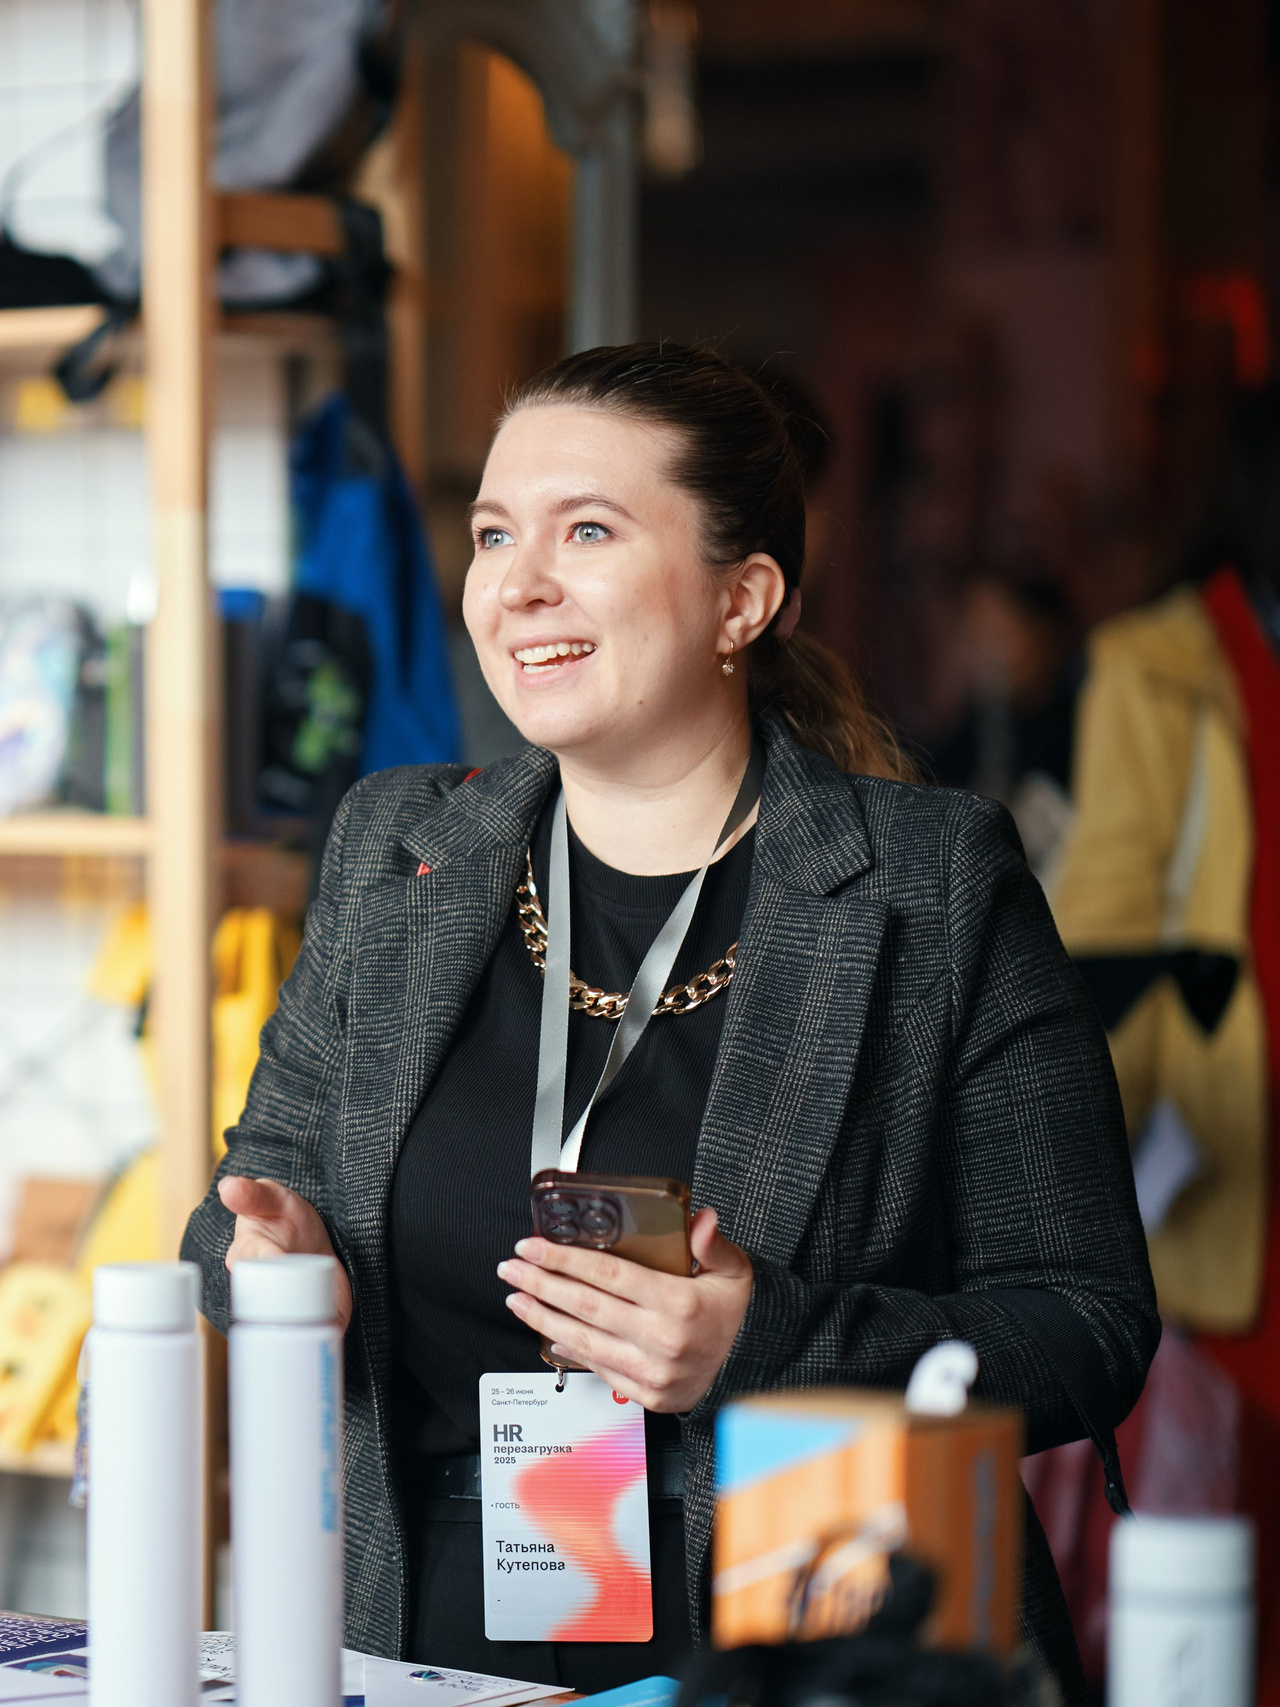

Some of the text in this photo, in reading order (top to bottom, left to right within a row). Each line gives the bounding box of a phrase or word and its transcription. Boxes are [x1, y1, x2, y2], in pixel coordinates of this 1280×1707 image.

[491, 1399, 549, 1407] Санкт-Петербург
[493, 1424, 523, 1442] HR
[493, 1445, 573, 1455] перезагрузка
[494, 1456, 516, 1464] 2025
[496, 1540, 555, 1553] Татьяна
[497, 1558, 566, 1574] Кутепова
